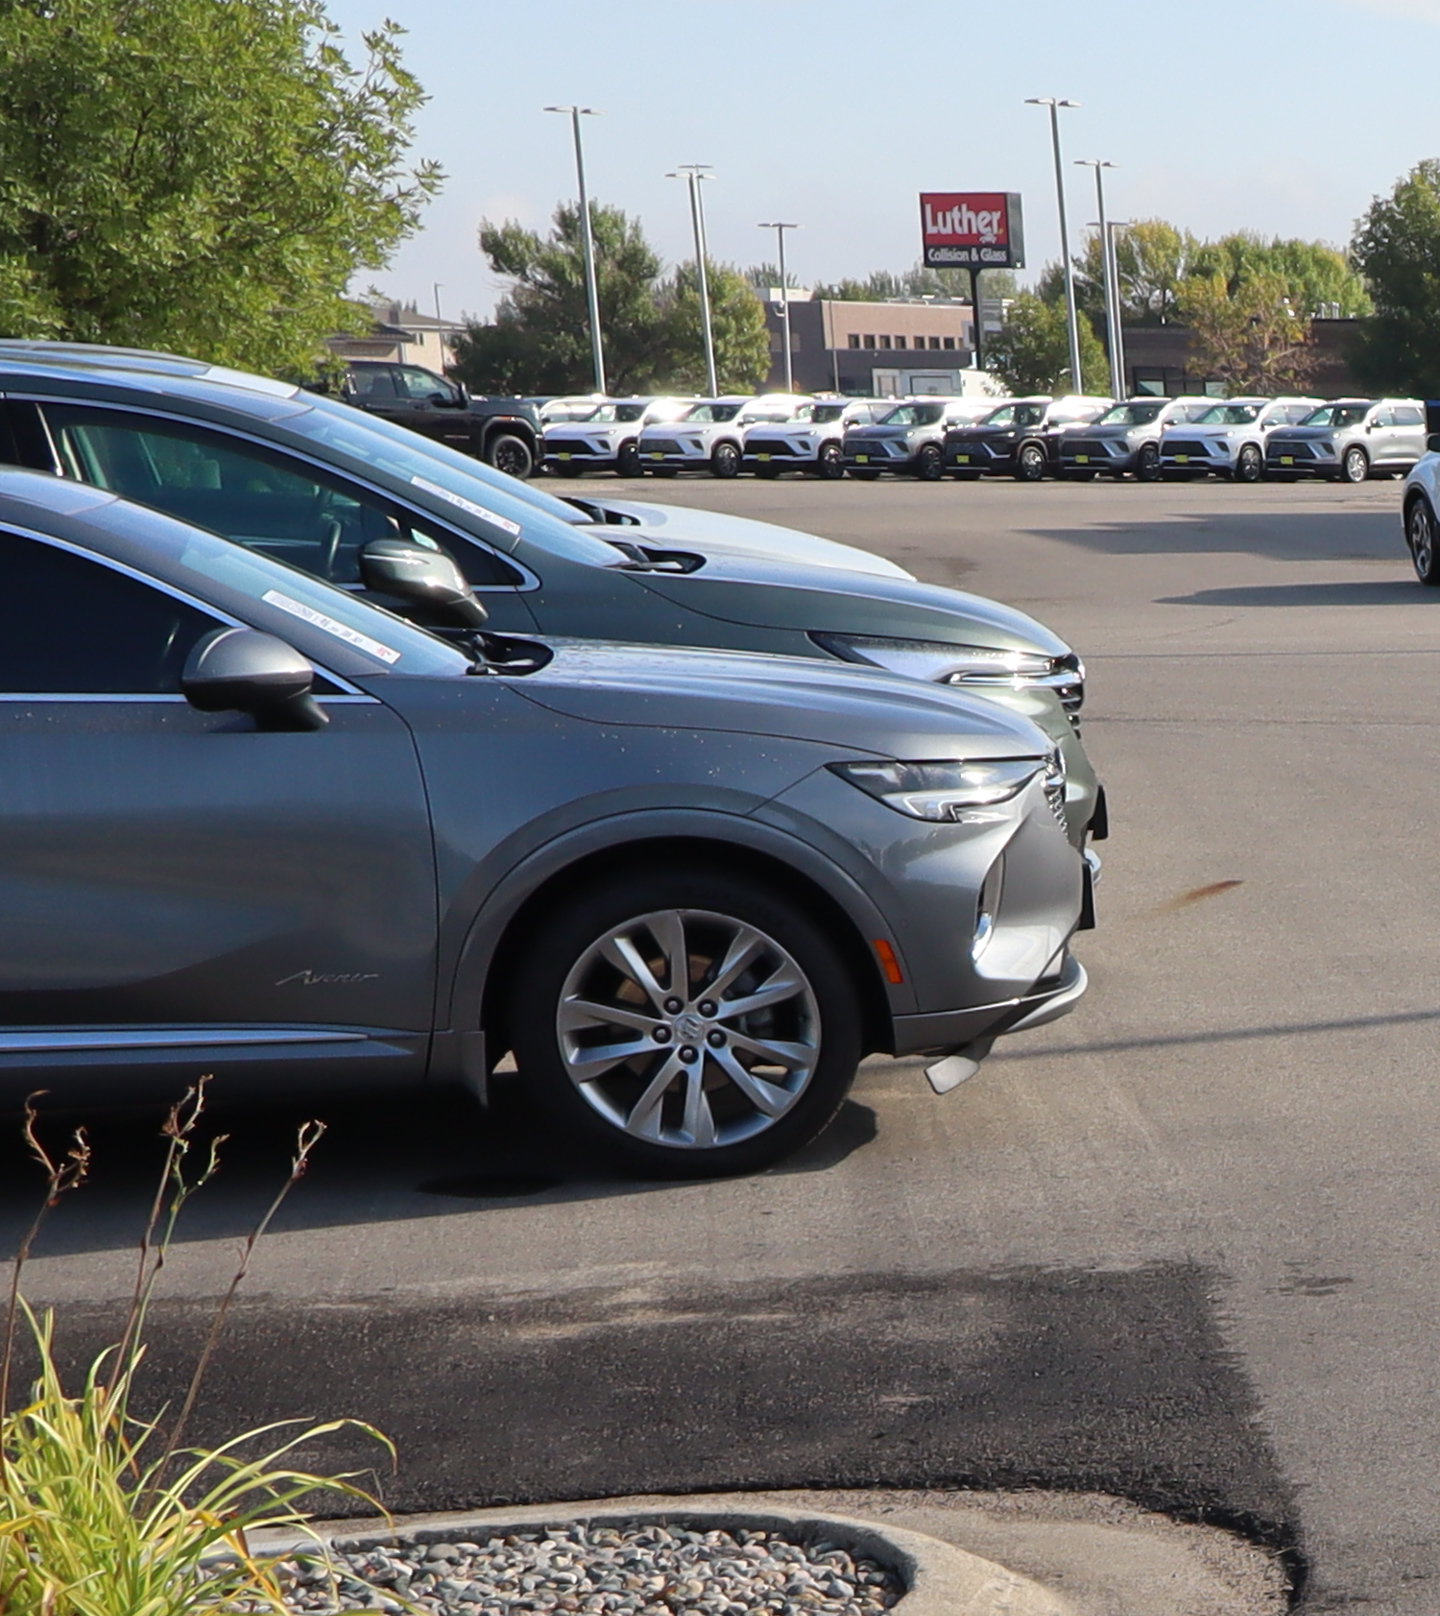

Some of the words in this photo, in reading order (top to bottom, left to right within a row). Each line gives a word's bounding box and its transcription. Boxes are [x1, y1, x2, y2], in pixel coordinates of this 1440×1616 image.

[925, 203, 1001, 234] Luther
[928, 247, 969, 262] Collision
[971, 247, 979, 262] &
[980, 247, 1007, 262] Glass
